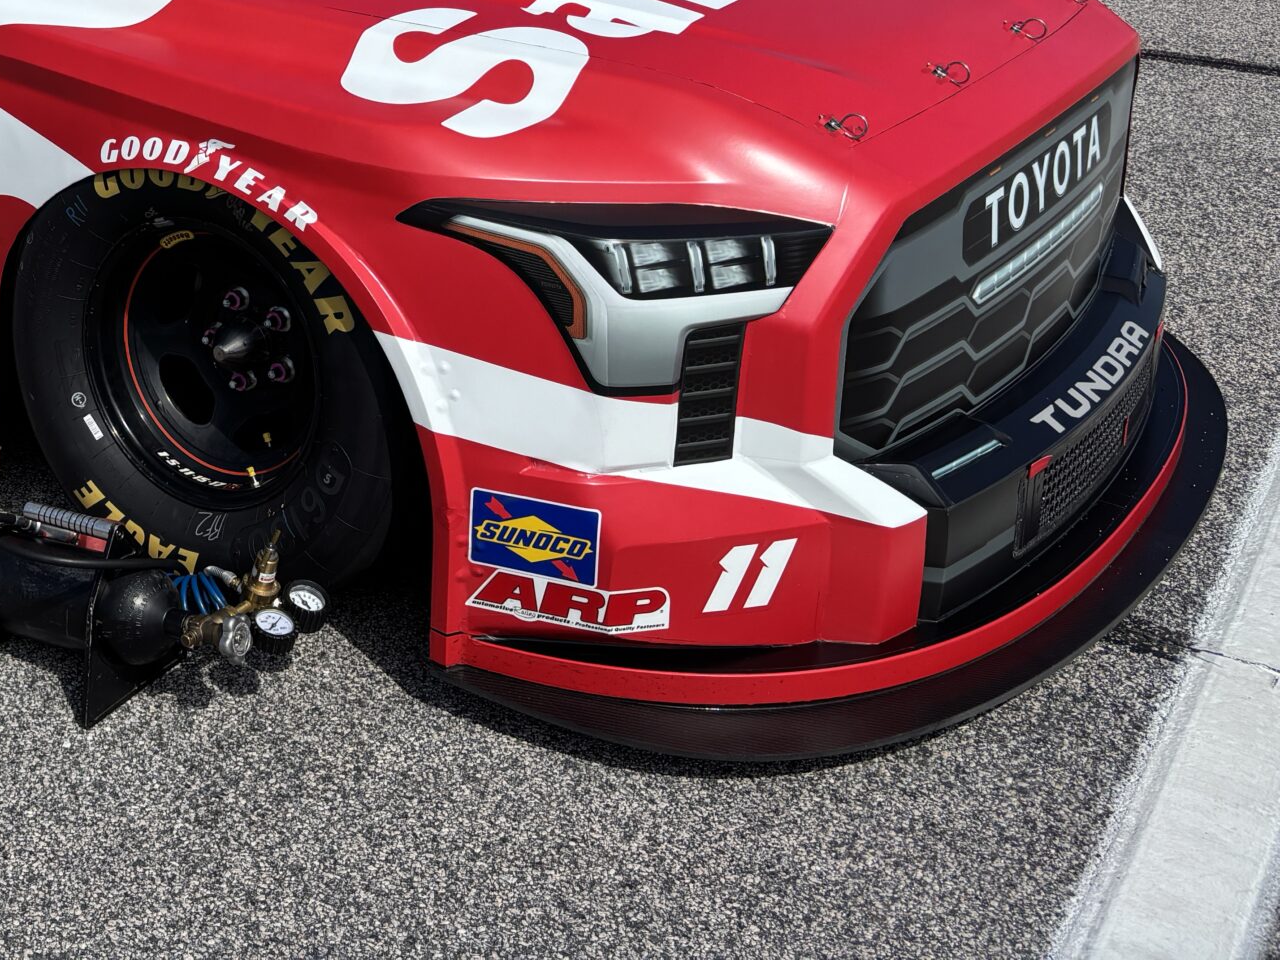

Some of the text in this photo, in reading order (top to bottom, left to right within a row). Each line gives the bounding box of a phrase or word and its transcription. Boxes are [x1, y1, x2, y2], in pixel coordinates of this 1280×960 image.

[984, 115, 1101, 247] TOYOTA
[1030, 321, 1150, 434] TUNDRA
[480, 521, 588, 559] SUNOCO
[473, 571, 666, 627] ARP
[702, 538, 798, 613] 11
[472, 599, 514, 612] automotive
[536, 613, 571, 624] products
[575, 621, 613, 632] Professional
[614, 624, 635, 632] Quality
